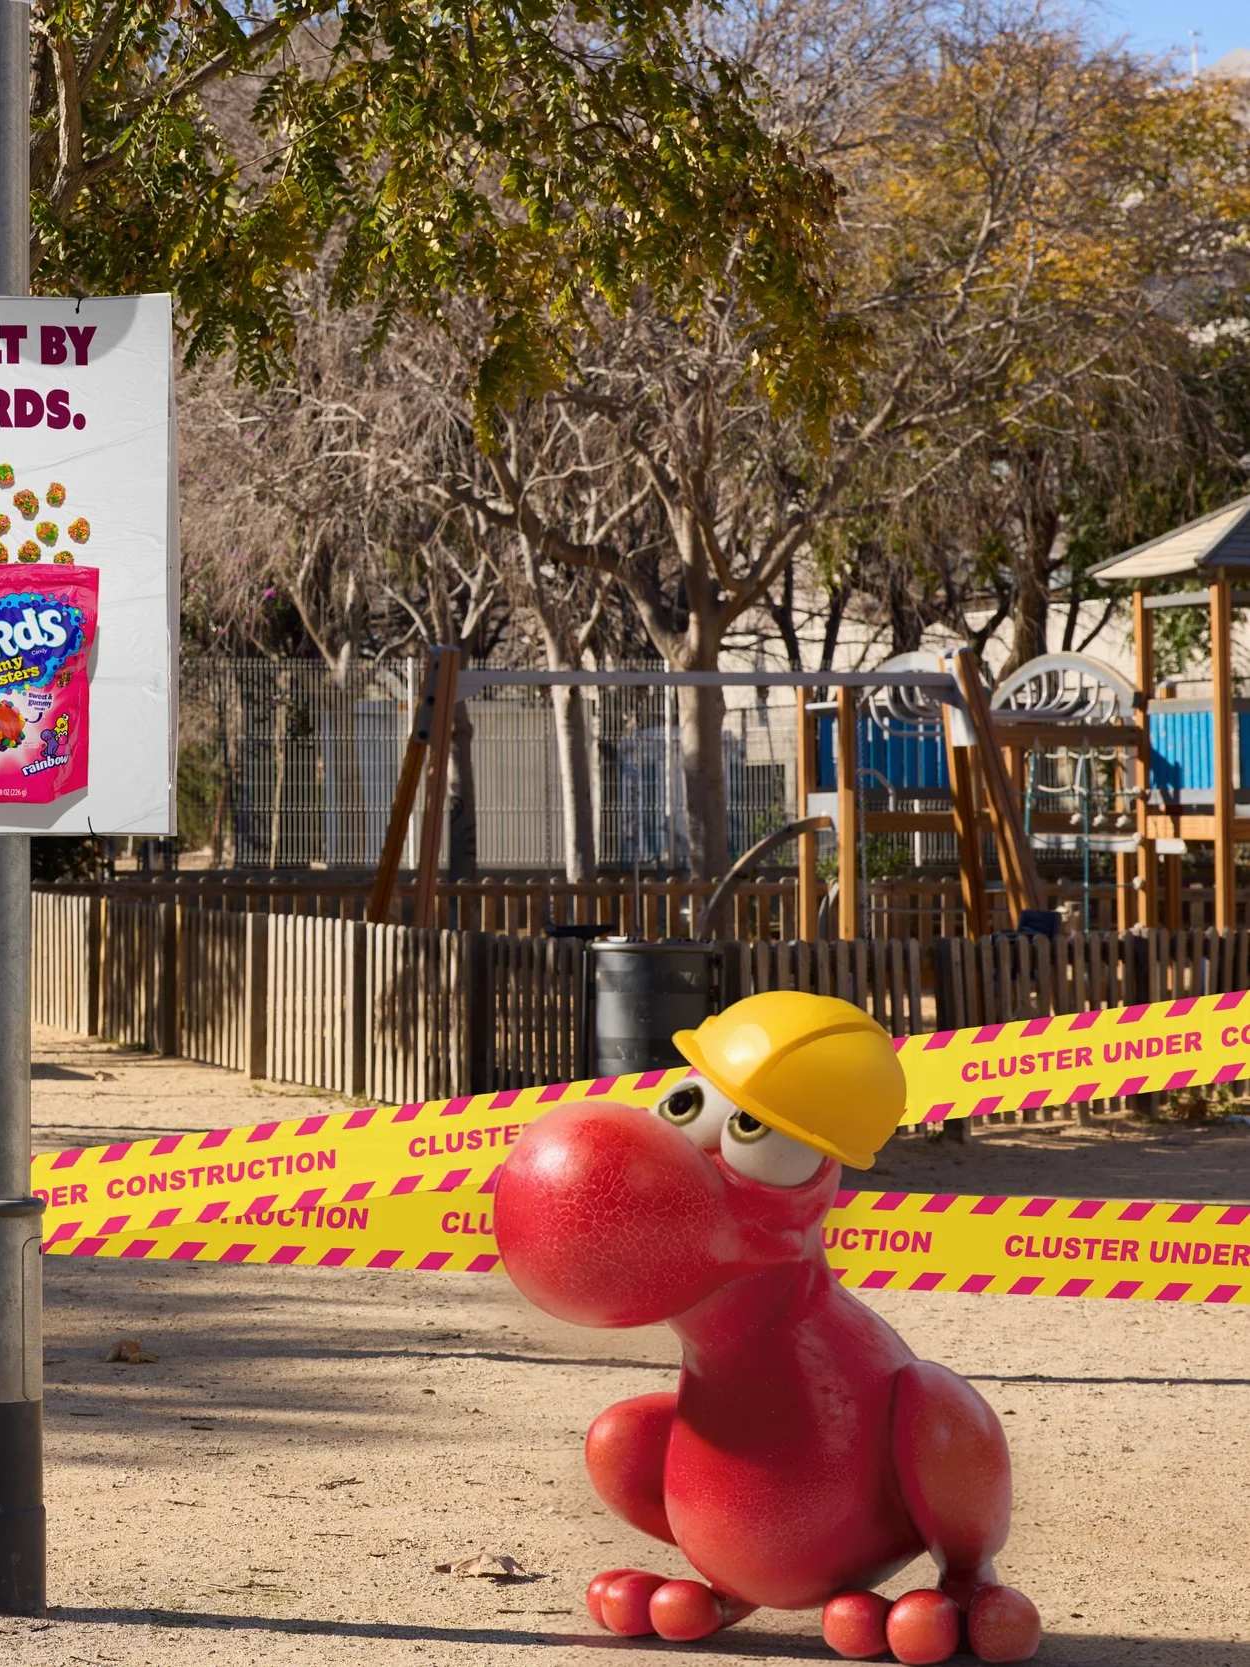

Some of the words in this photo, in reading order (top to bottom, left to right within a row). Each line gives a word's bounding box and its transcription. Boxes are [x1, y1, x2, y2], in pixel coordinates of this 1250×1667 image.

[40, 325, 98, 366] BY
[27, 699, 53, 709] gummy
[28, 692, 48, 700] sweet
[22, 755, 70, 776] rainbow
[961, 1046, 1093, 1083] CLUSTER
[1103, 1031, 1202, 1064] UNDER
[408, 1124, 520, 1158] CLUSTE
[32, 1184, 88, 1207] DER
[107, 1149, 336, 1199] CONSTRUCTION
[1004, 1234, 1140, 1262] CLUSTER
[1149, 1240, 1250, 1267] UNDER
